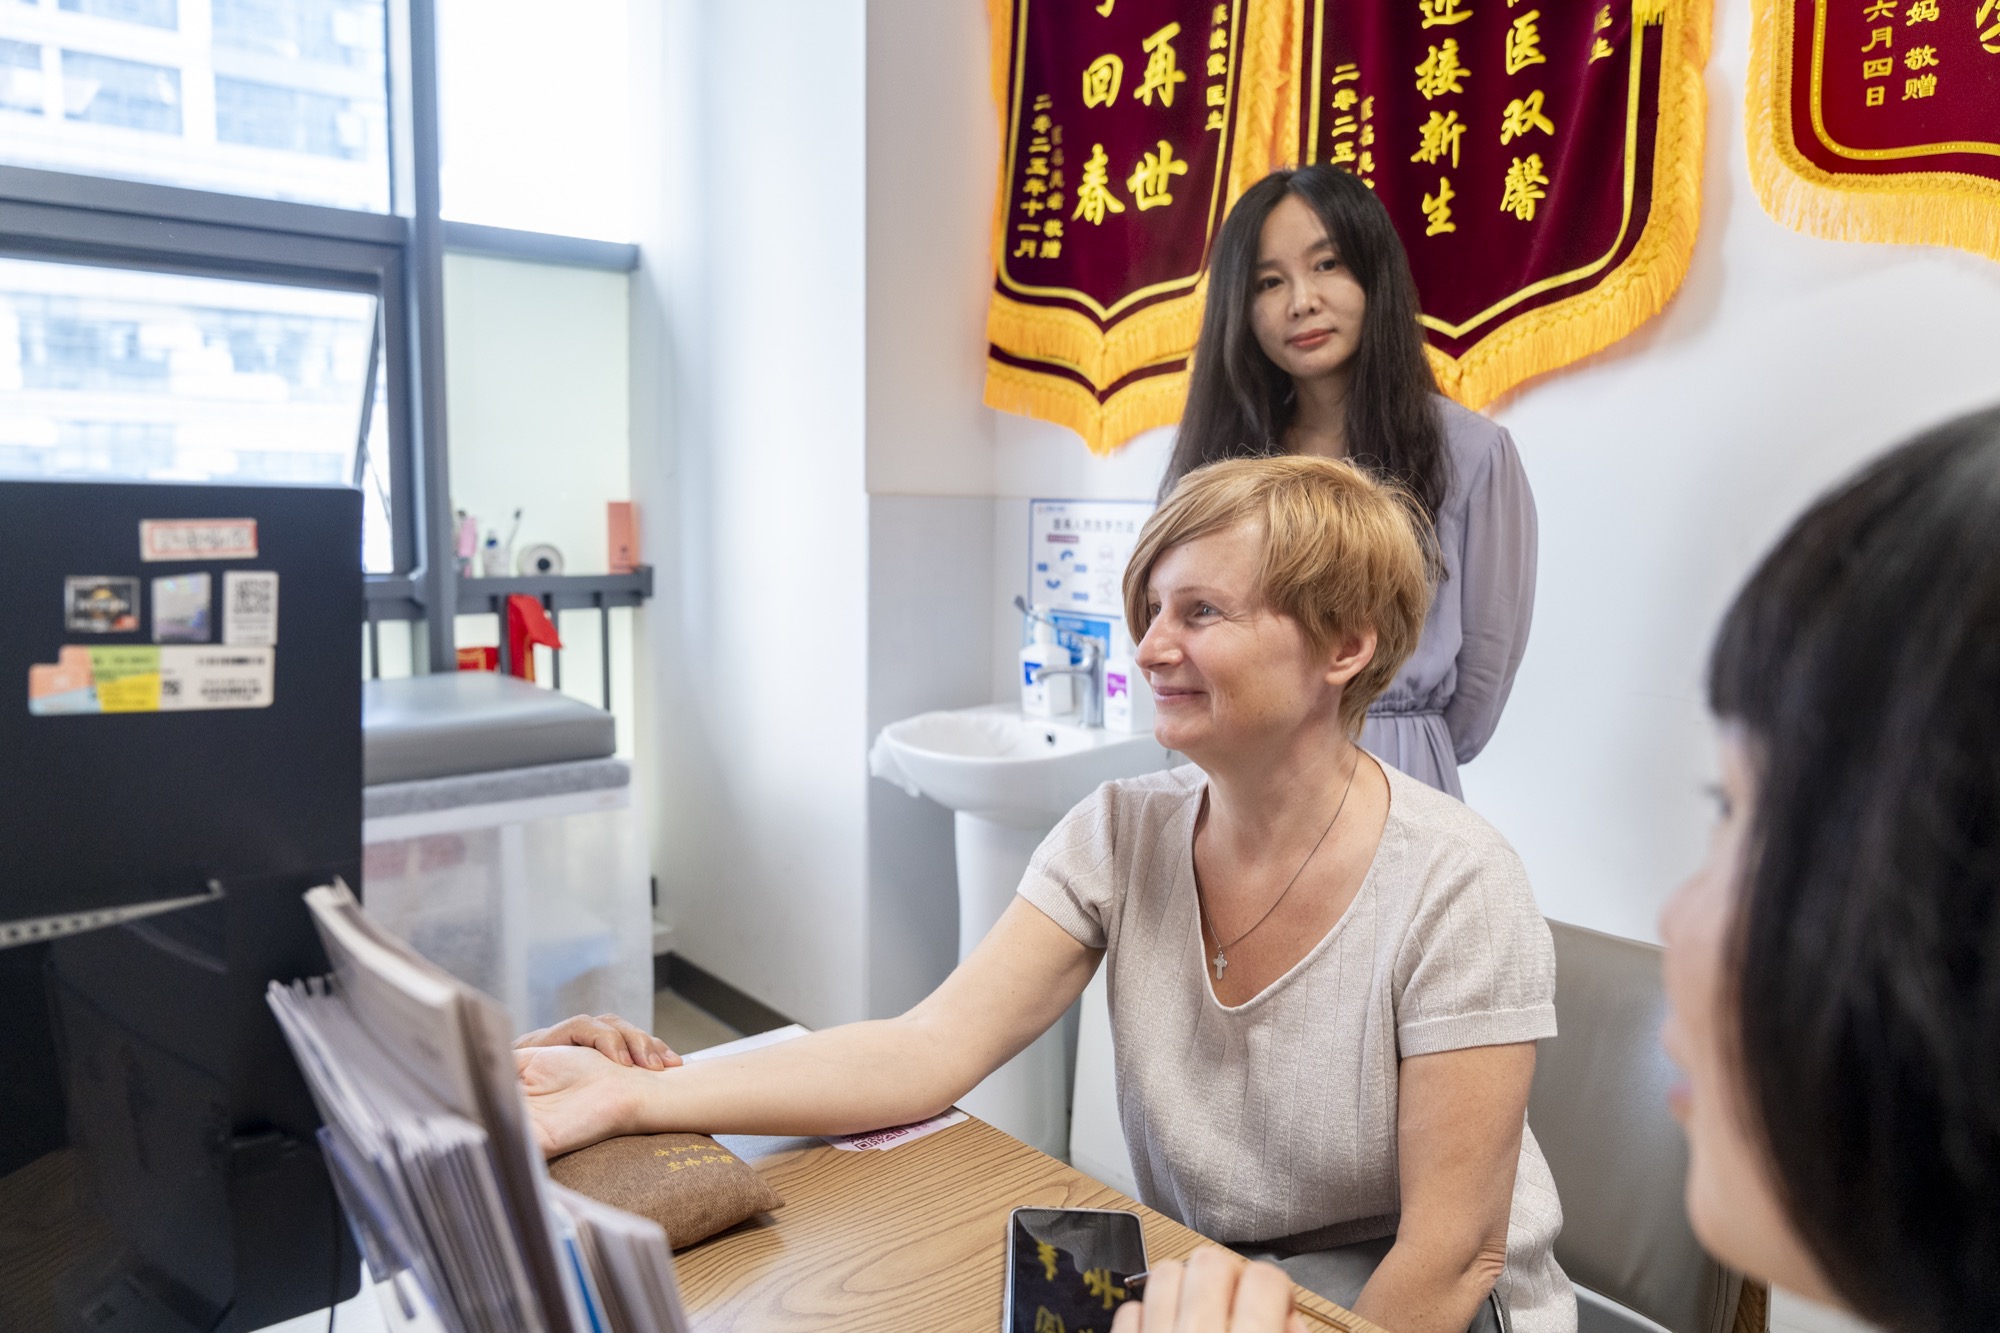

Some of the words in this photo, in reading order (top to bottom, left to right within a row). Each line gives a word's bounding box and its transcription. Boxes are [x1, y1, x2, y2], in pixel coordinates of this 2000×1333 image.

[1862, 0, 1898, 106] 六月四日
[1902, 45, 1939, 100] 敬赠
[1127, 22, 1188, 212] 再世
[1331, 63, 1361, 174] 二零二五
[1500, 0, 1554, 221] 医双馨
